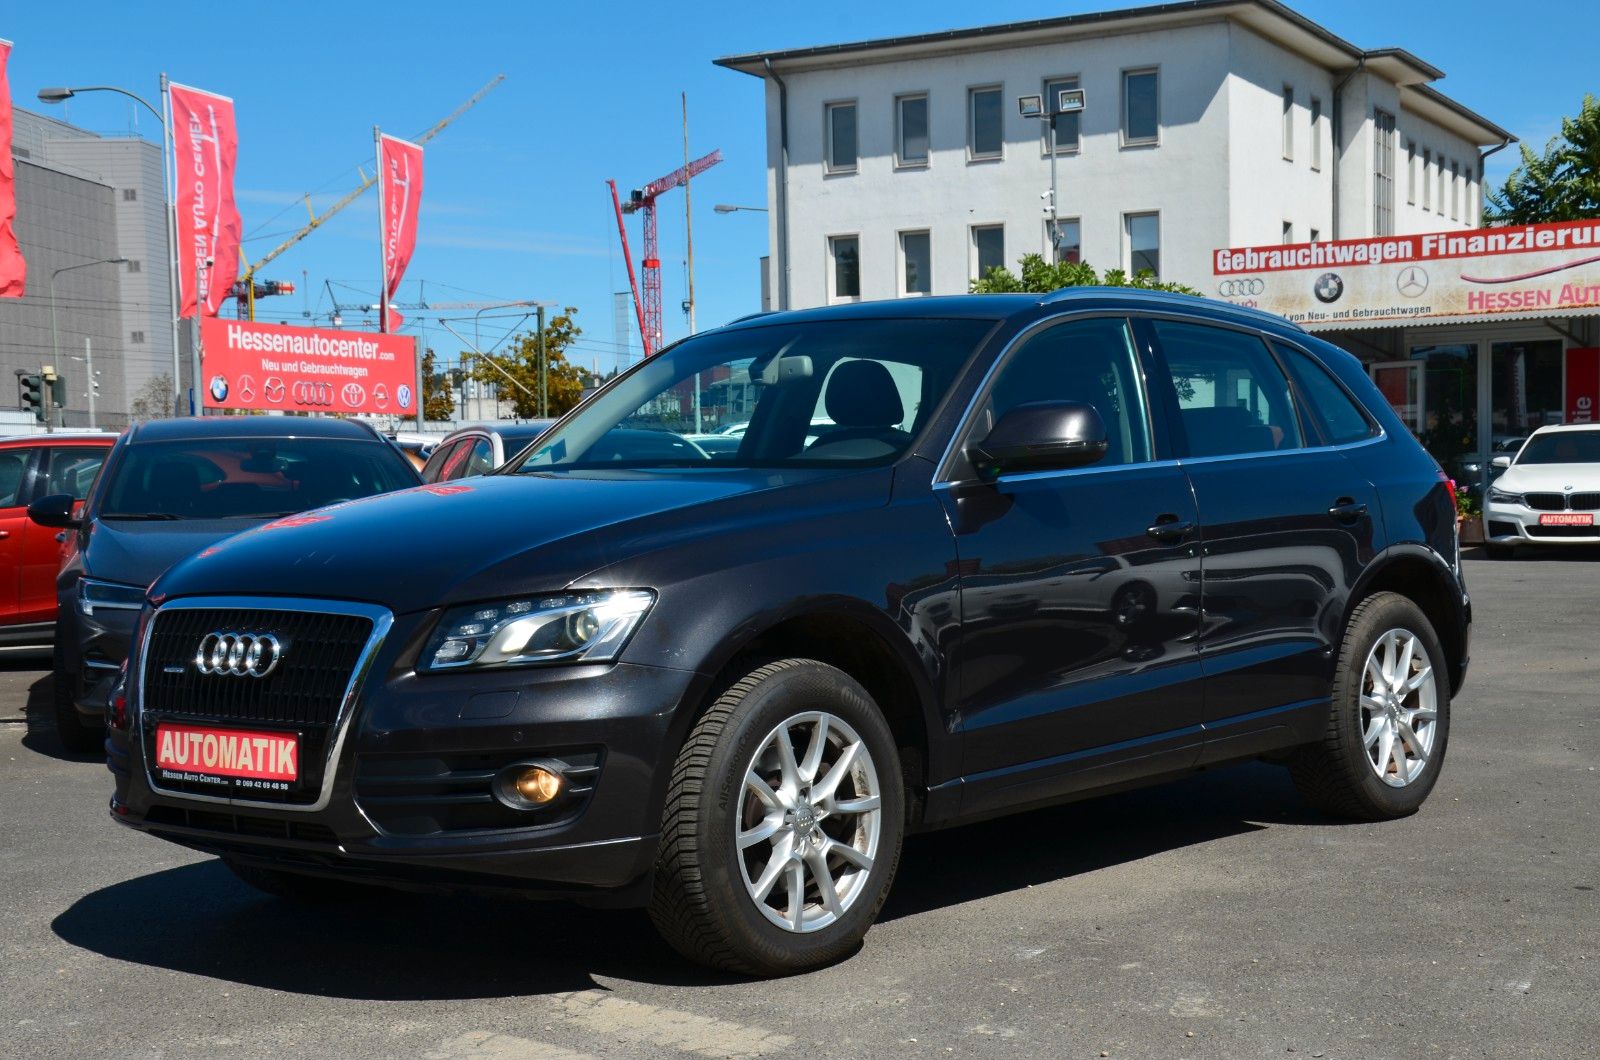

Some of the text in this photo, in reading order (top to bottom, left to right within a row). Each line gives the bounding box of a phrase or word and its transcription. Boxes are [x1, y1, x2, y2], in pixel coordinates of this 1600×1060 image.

[1217, 239, 1412, 272] Gebrauchtwagen
[1467, 289, 1552, 311] HESSEN
[1289, 313, 1305, 321] von
[1307, 311, 1330, 320] Neu-
[1332, 309, 1350, 319] und
[1352, 305, 1432, 318] Gebrauchtwagen
[261, 358, 368, 379] Neu und Gebrauchtwagen
[1541, 514, 1593, 525] AUTOMATIK
[160, 731, 297, 775] AUTOMATIK
[254, 781, 261, 789] 42
